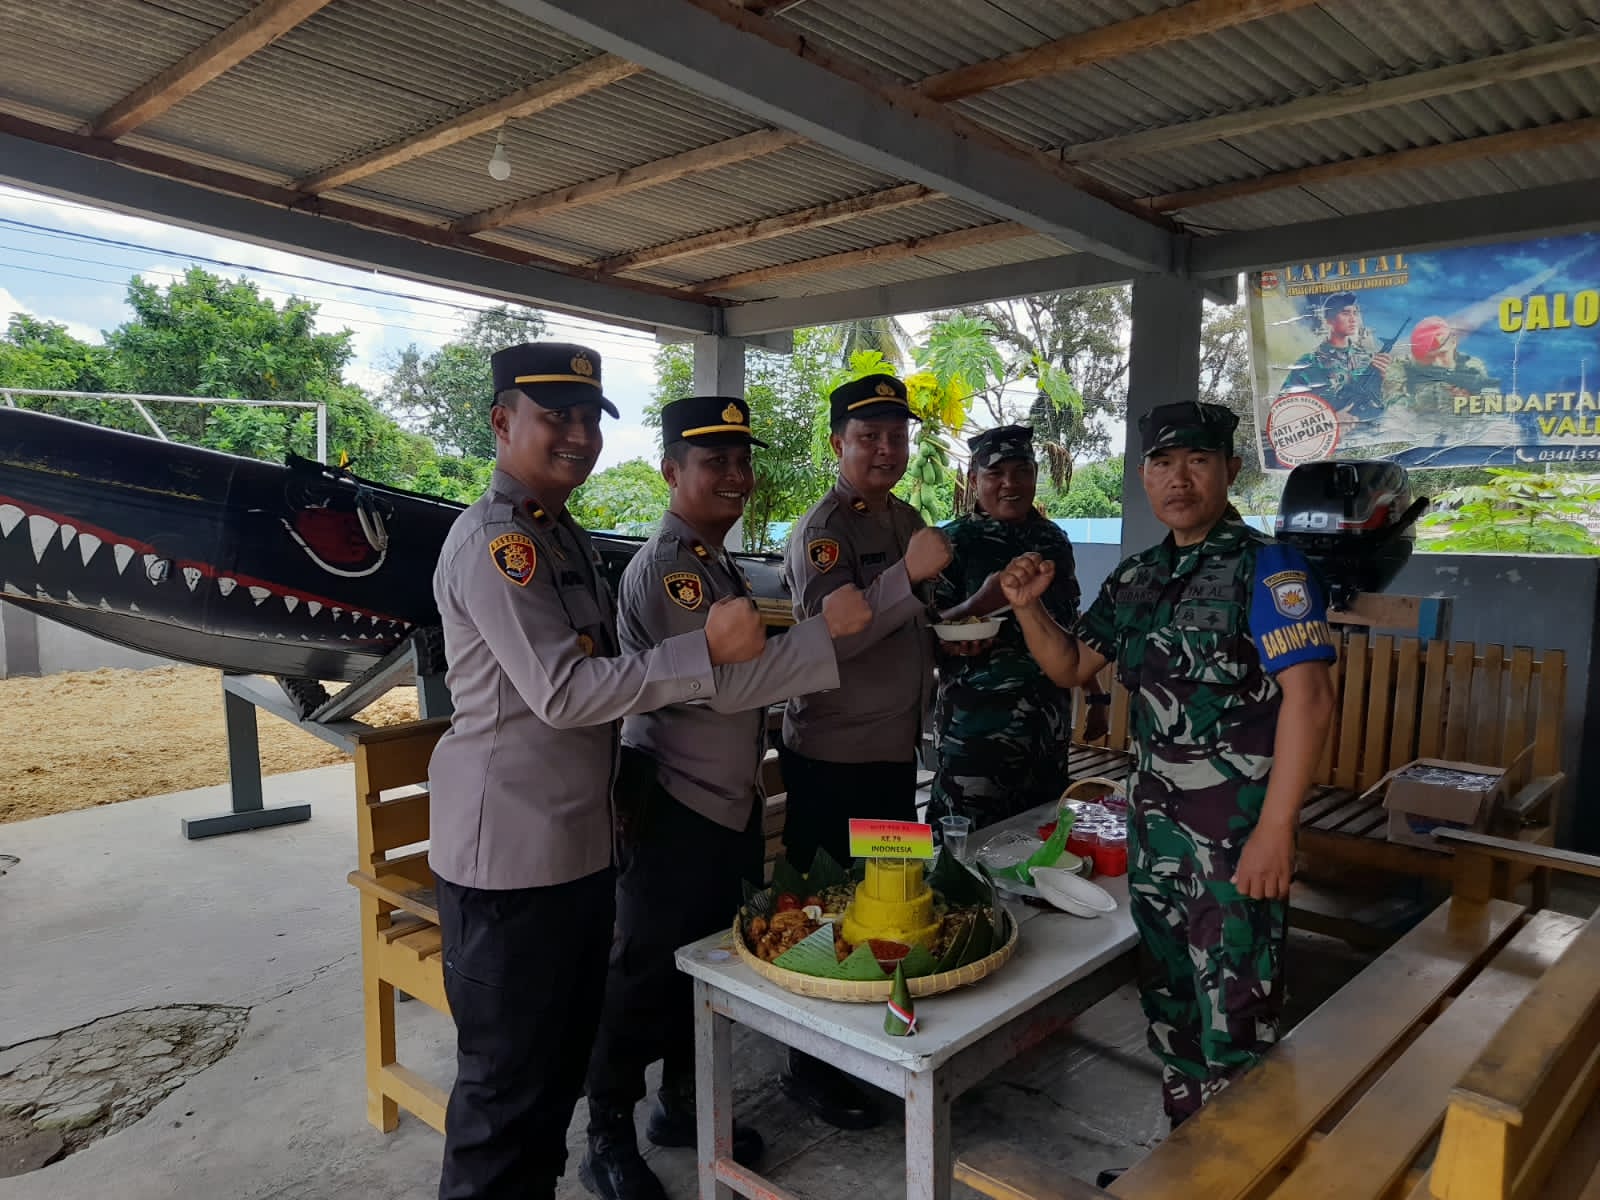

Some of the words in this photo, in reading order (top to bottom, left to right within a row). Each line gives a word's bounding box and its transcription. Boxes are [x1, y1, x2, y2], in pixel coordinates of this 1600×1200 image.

[1498, 289, 1600, 332] CALO
[1454, 391, 1600, 414] PENDAFTA
[1301, 413, 1326, 428] HATI
[1274, 421, 1334, 448] PENIPUAN
[1291, 511, 1329, 529] 40
[871, 845, 912, 853] INDONESIA
